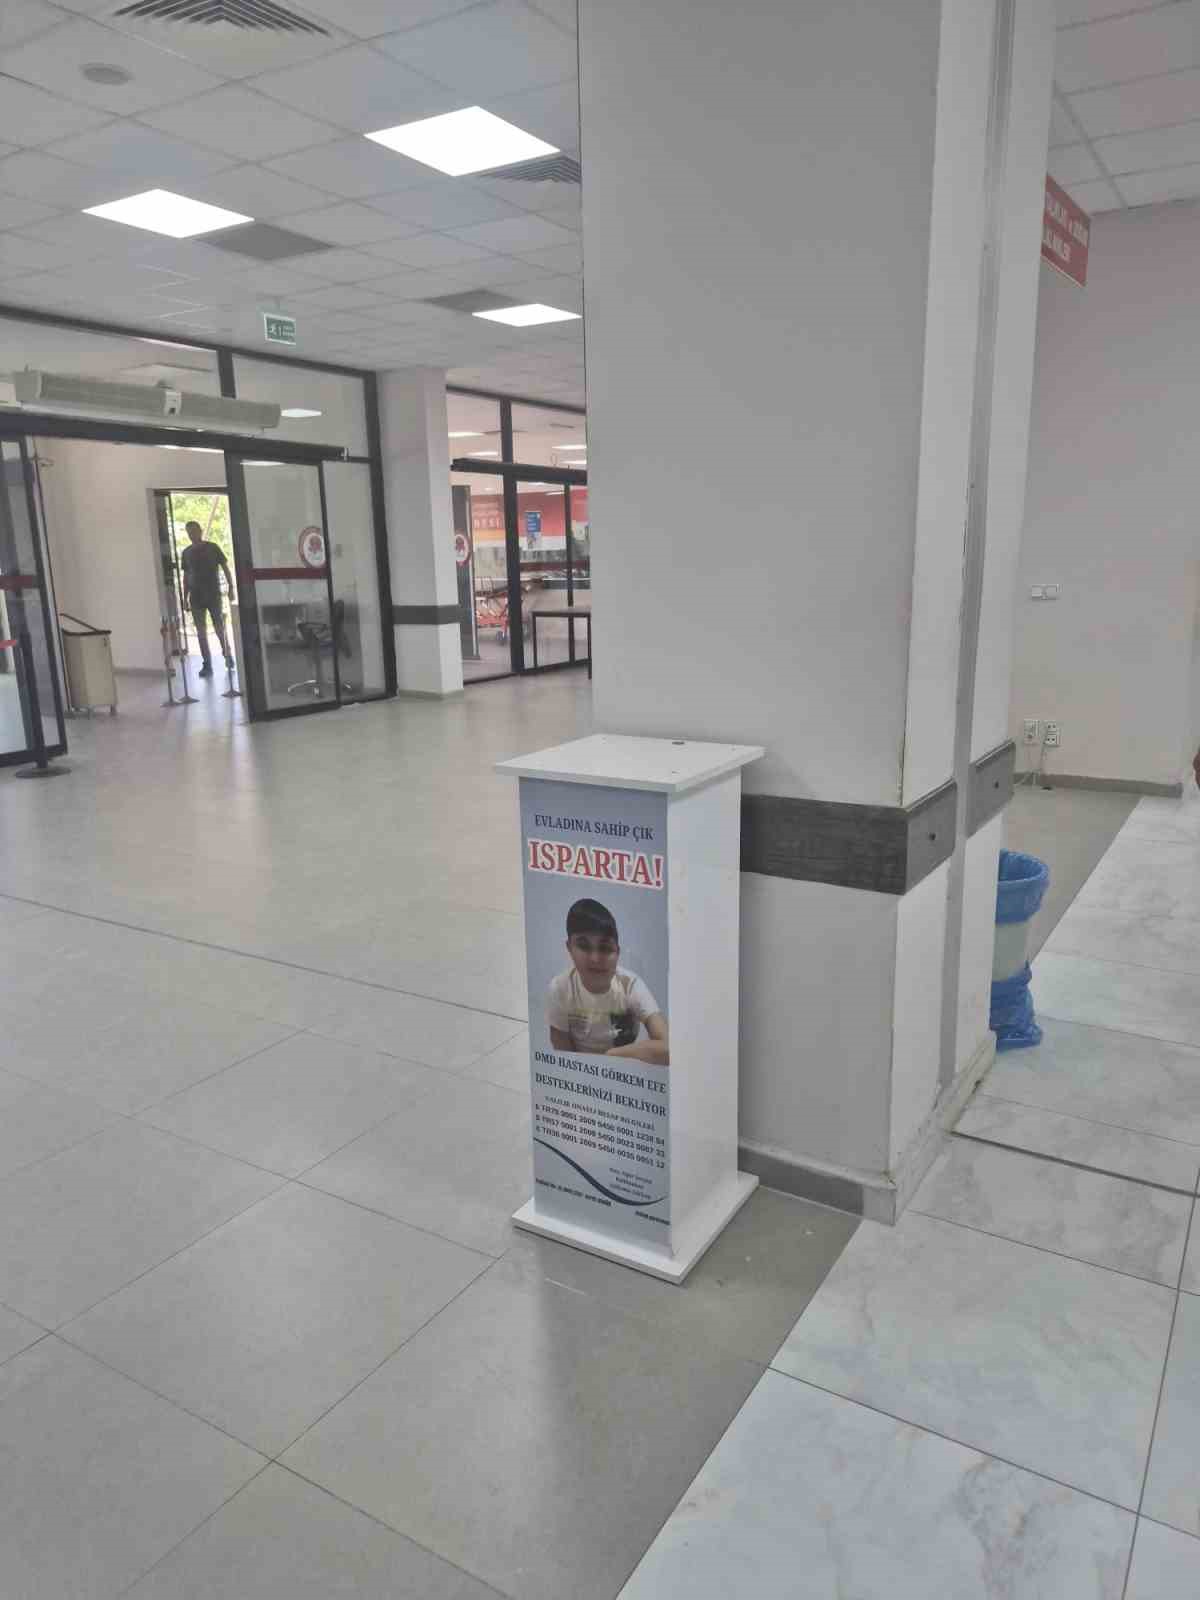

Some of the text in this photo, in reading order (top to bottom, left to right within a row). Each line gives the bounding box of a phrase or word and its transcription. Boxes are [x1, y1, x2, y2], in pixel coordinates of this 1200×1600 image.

[535, 814, 655, 842] EVLADINA SAHİP ÇIK
[528, 840, 664, 888] ISPARTA!
[535, 1051, 556, 1064] DMD
[601, 1067, 645, 1088] GÖRKEM
[647, 1080, 666, 1094] EFE
[615, 1094, 667, 1117] BEKLİYOR
